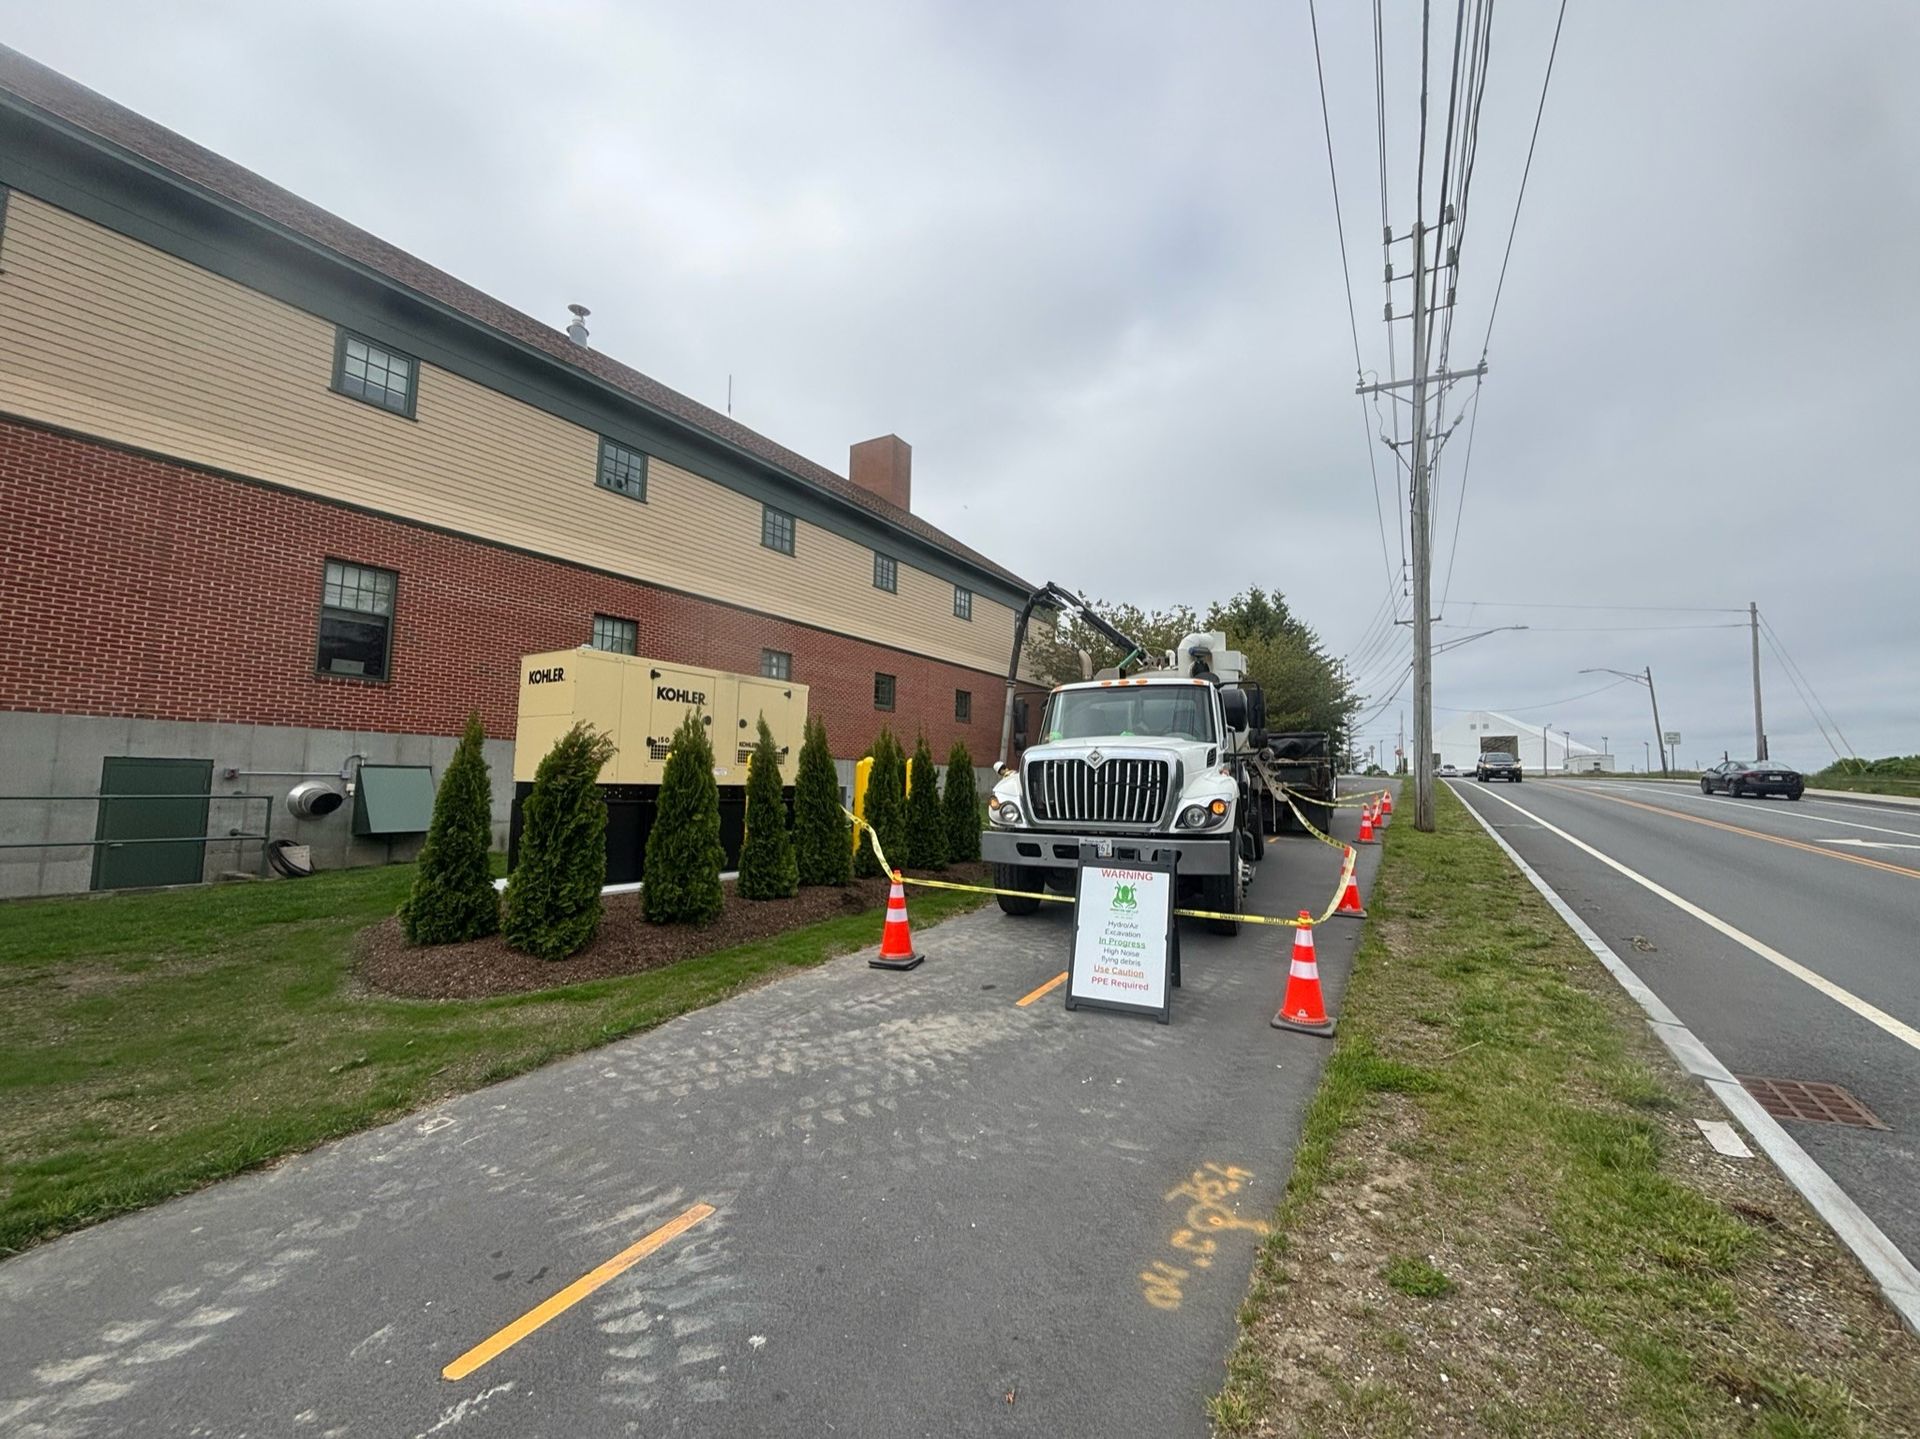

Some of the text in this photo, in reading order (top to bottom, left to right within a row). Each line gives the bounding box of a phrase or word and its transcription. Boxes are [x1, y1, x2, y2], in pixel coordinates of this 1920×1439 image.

[528, 667, 564, 685] KOHLER
[656, 686, 706, 705] KOHLER
[1101, 869, 1153, 881] WARNING
[1108, 920, 1138, 930] Hydro/Air
[1105, 929, 1141, 939] Excavation
[1099, 937, 1146, 949] In Progress
[1104, 947, 1140, 957] High Noise
[1101, 956, 1141, 967] flying debris
[1094, 965, 1144, 979] Use Caution
[1091, 976, 1149, 991] PPE Required
